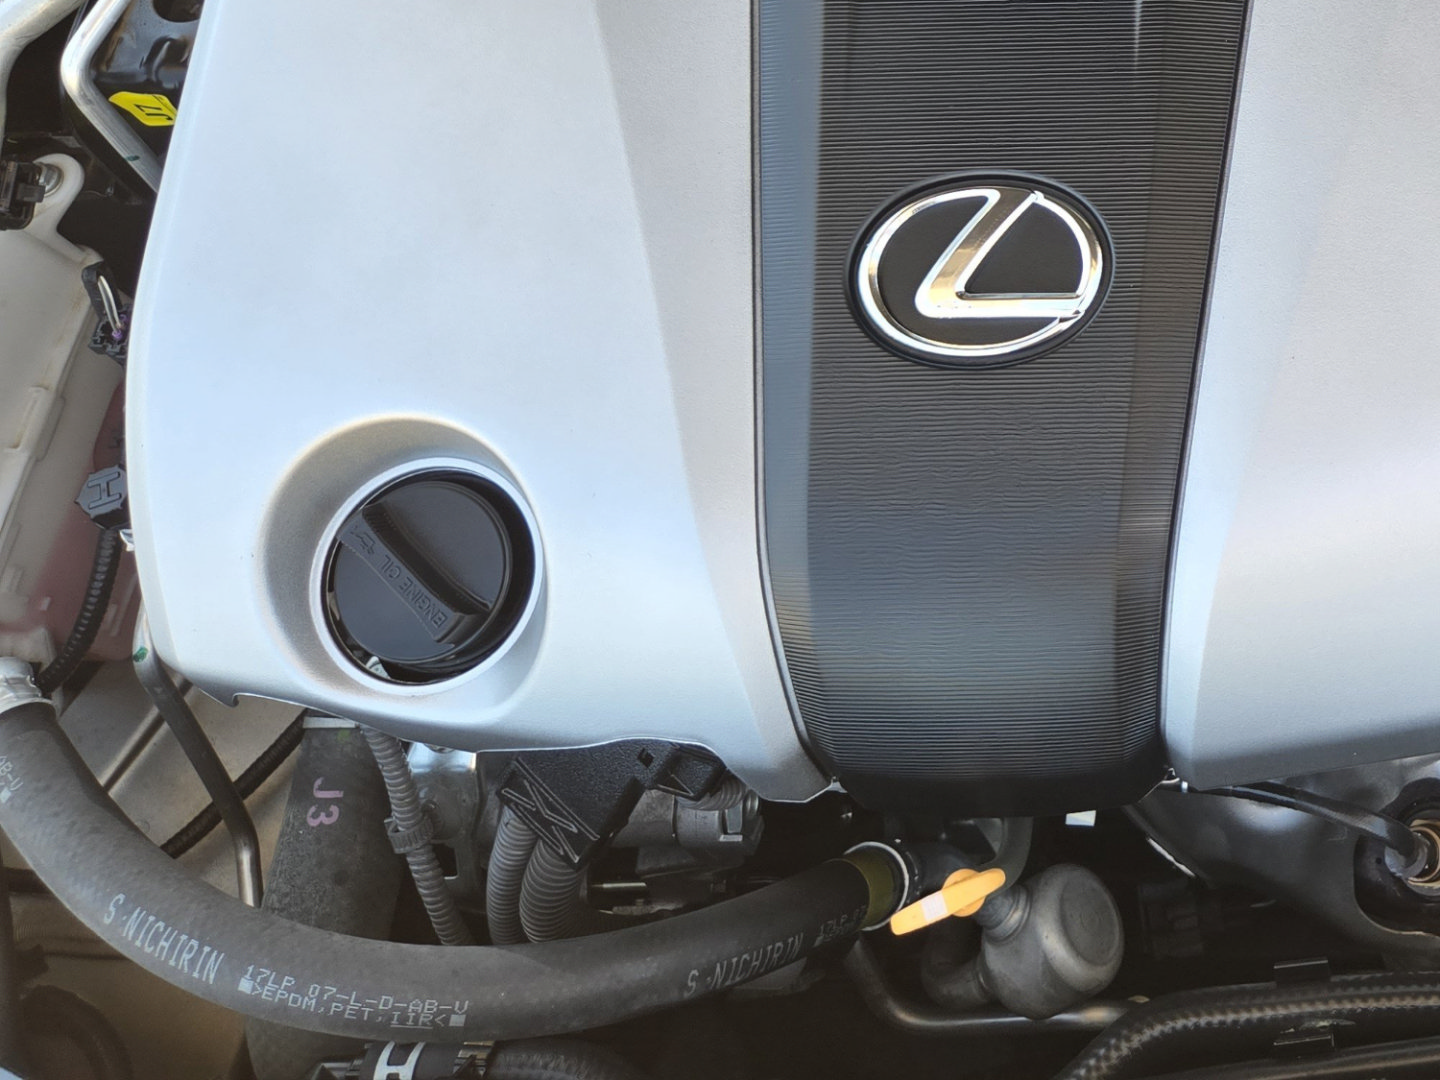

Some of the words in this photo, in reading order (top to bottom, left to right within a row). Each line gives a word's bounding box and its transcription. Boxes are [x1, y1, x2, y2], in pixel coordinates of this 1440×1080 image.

[378, 554, 401, 583] OIL
[398, 576, 448, 628] ENGINE
[306, 777, 344, 827] J3
[245, 965, 295, 991] 17LP
